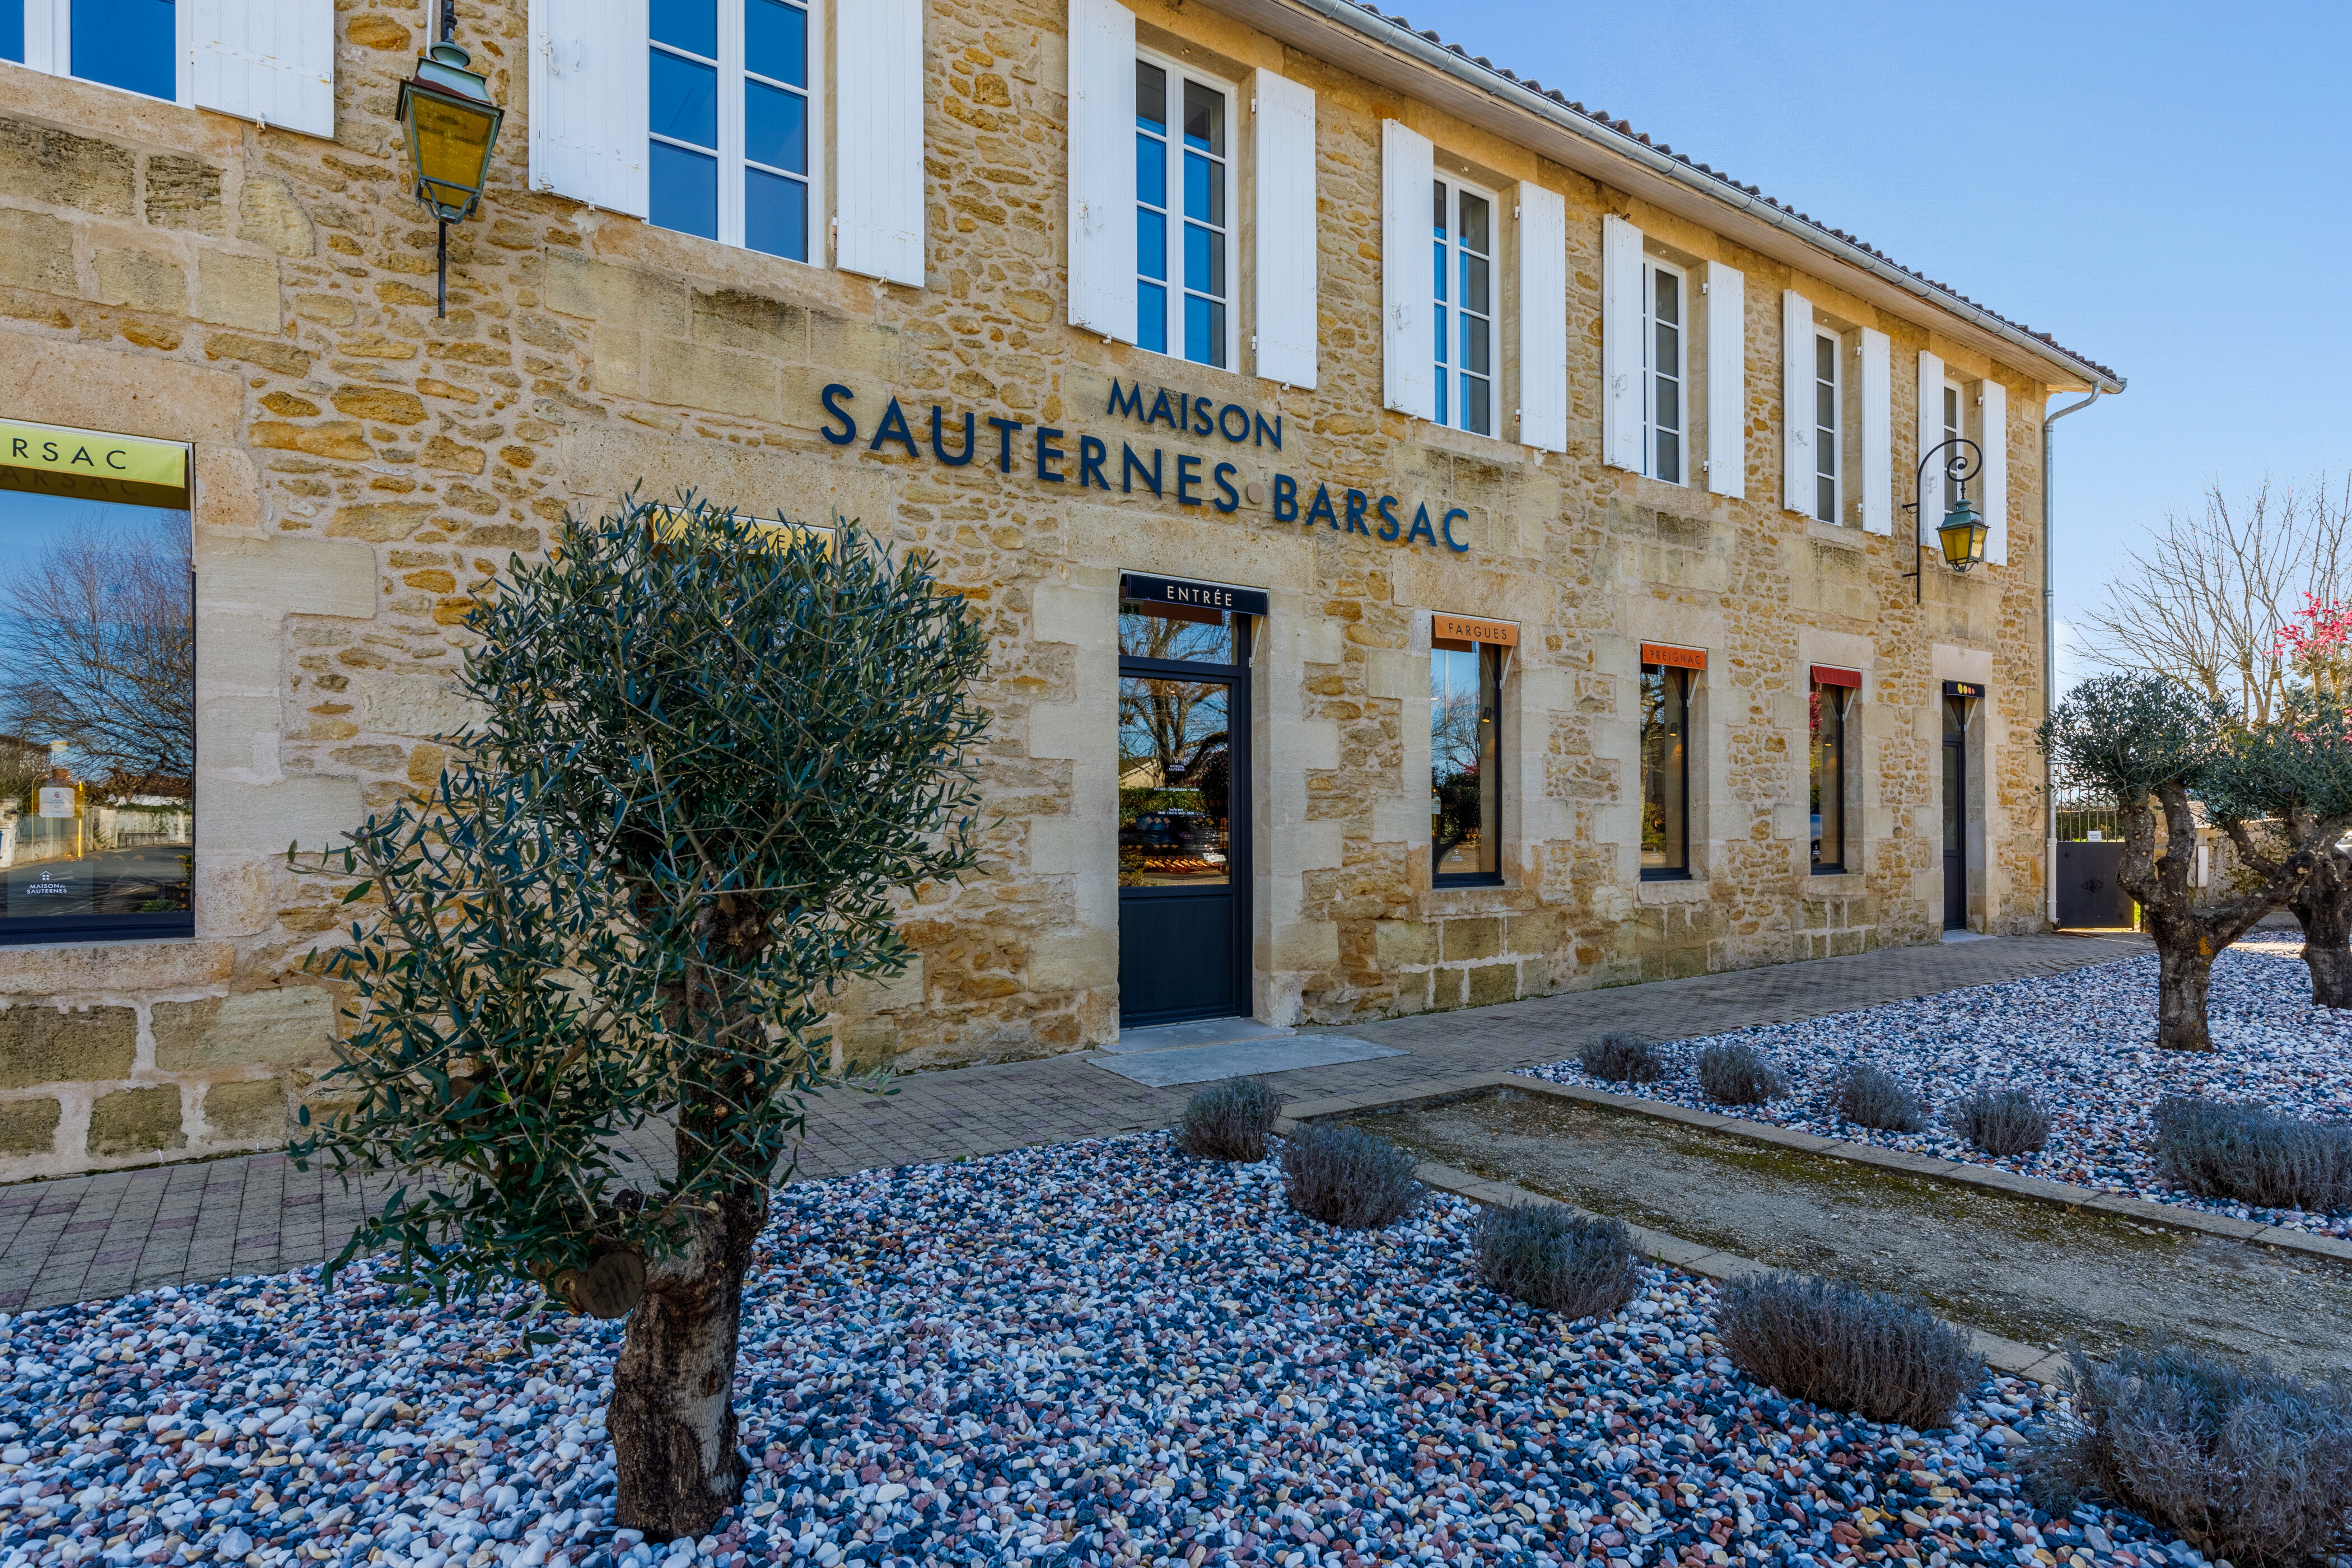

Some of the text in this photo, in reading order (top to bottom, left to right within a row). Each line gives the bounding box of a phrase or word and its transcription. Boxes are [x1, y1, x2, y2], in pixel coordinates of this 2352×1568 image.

[1107, 377, 1282, 451] MAISON
[12, 437, 127, 470] RSAC
[820, 382, 1470, 553] SAUTERNES BARSAC
[1166, 585, 1233, 607] ENTRÉE
[1448, 622, 1508, 641] FARGUES
[1649, 649, 1701, 665] PREIGNAC
[1815, 670, 1860, 684] SAUTERNES
